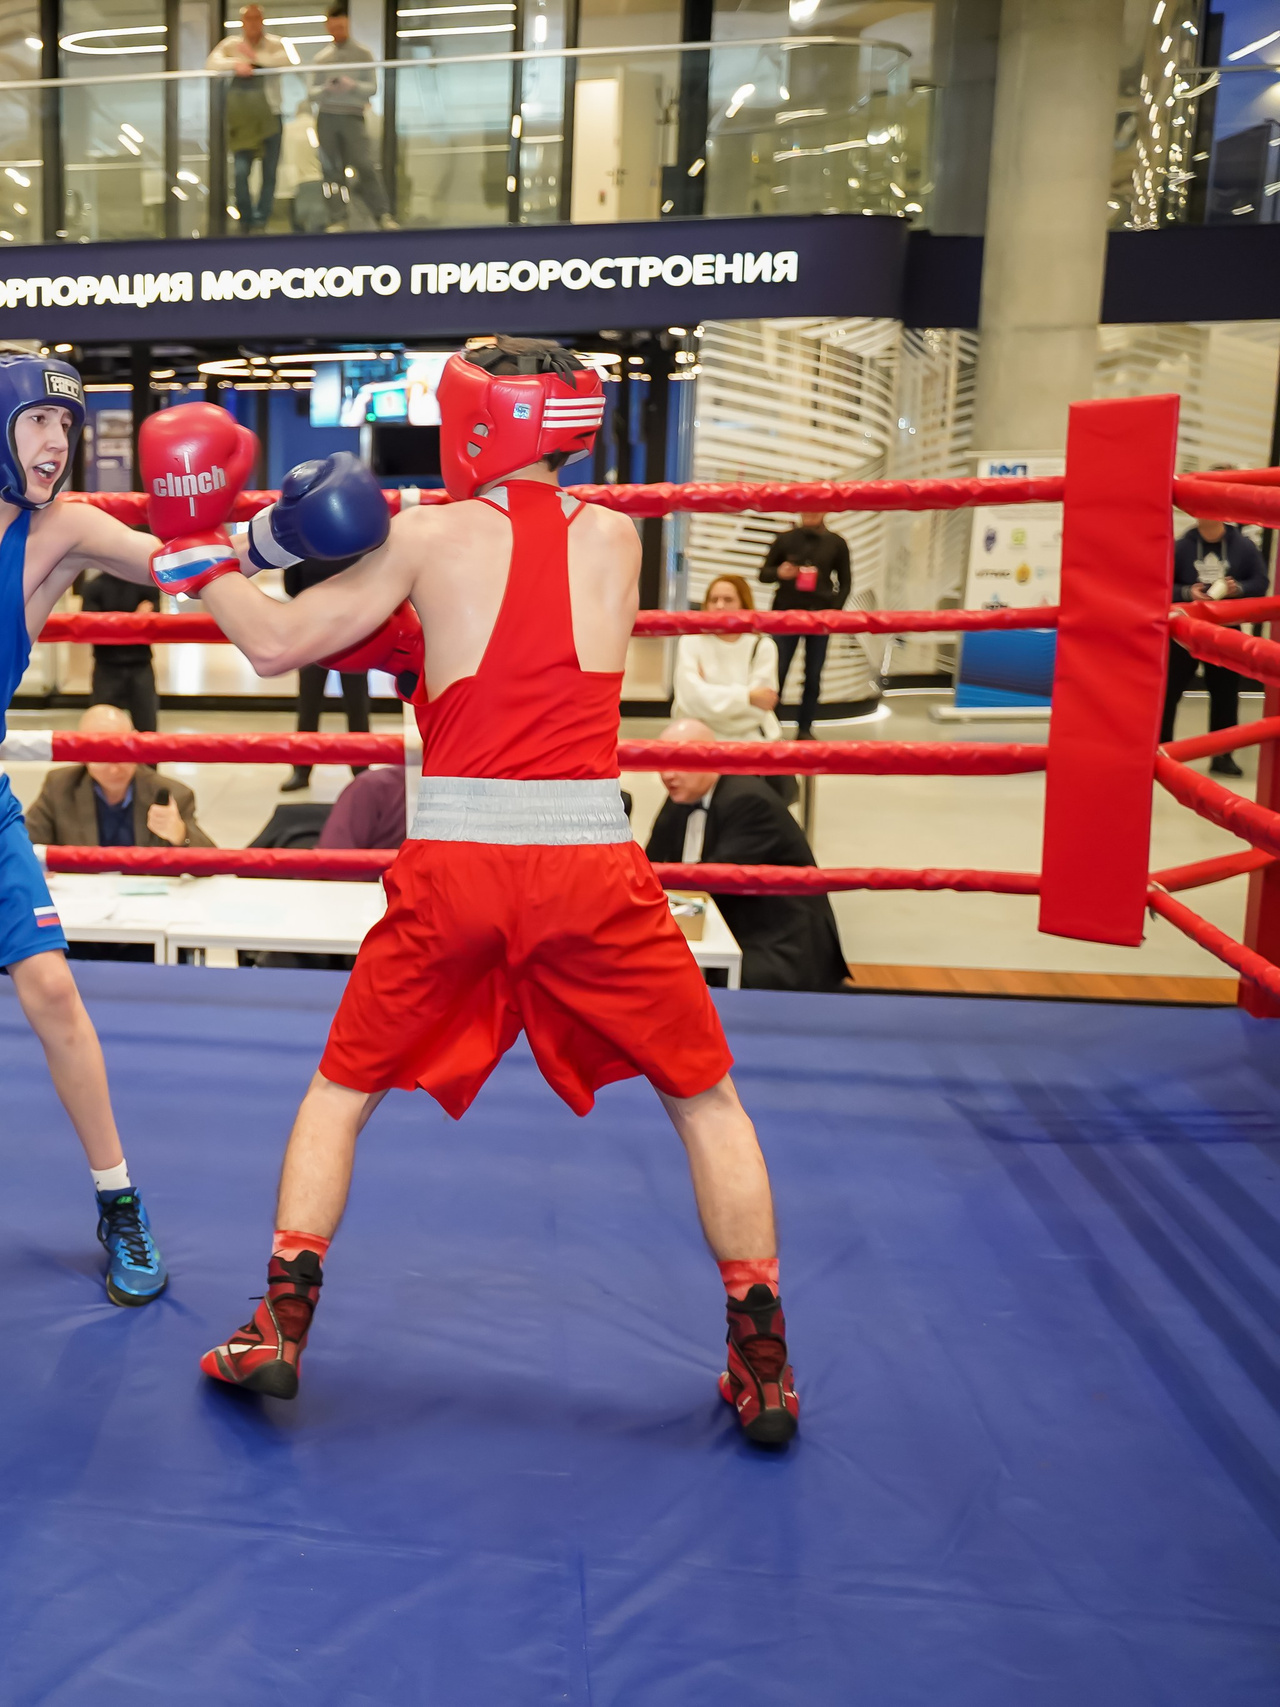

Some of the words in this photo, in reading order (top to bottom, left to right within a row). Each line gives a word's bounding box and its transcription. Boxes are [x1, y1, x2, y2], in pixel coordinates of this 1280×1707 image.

[201, 265, 402, 301] МОРСКОГО
[410, 250, 799, 295] ПРИБОРОСТРОЕНИЯ
[153, 465, 226, 498] clinch
